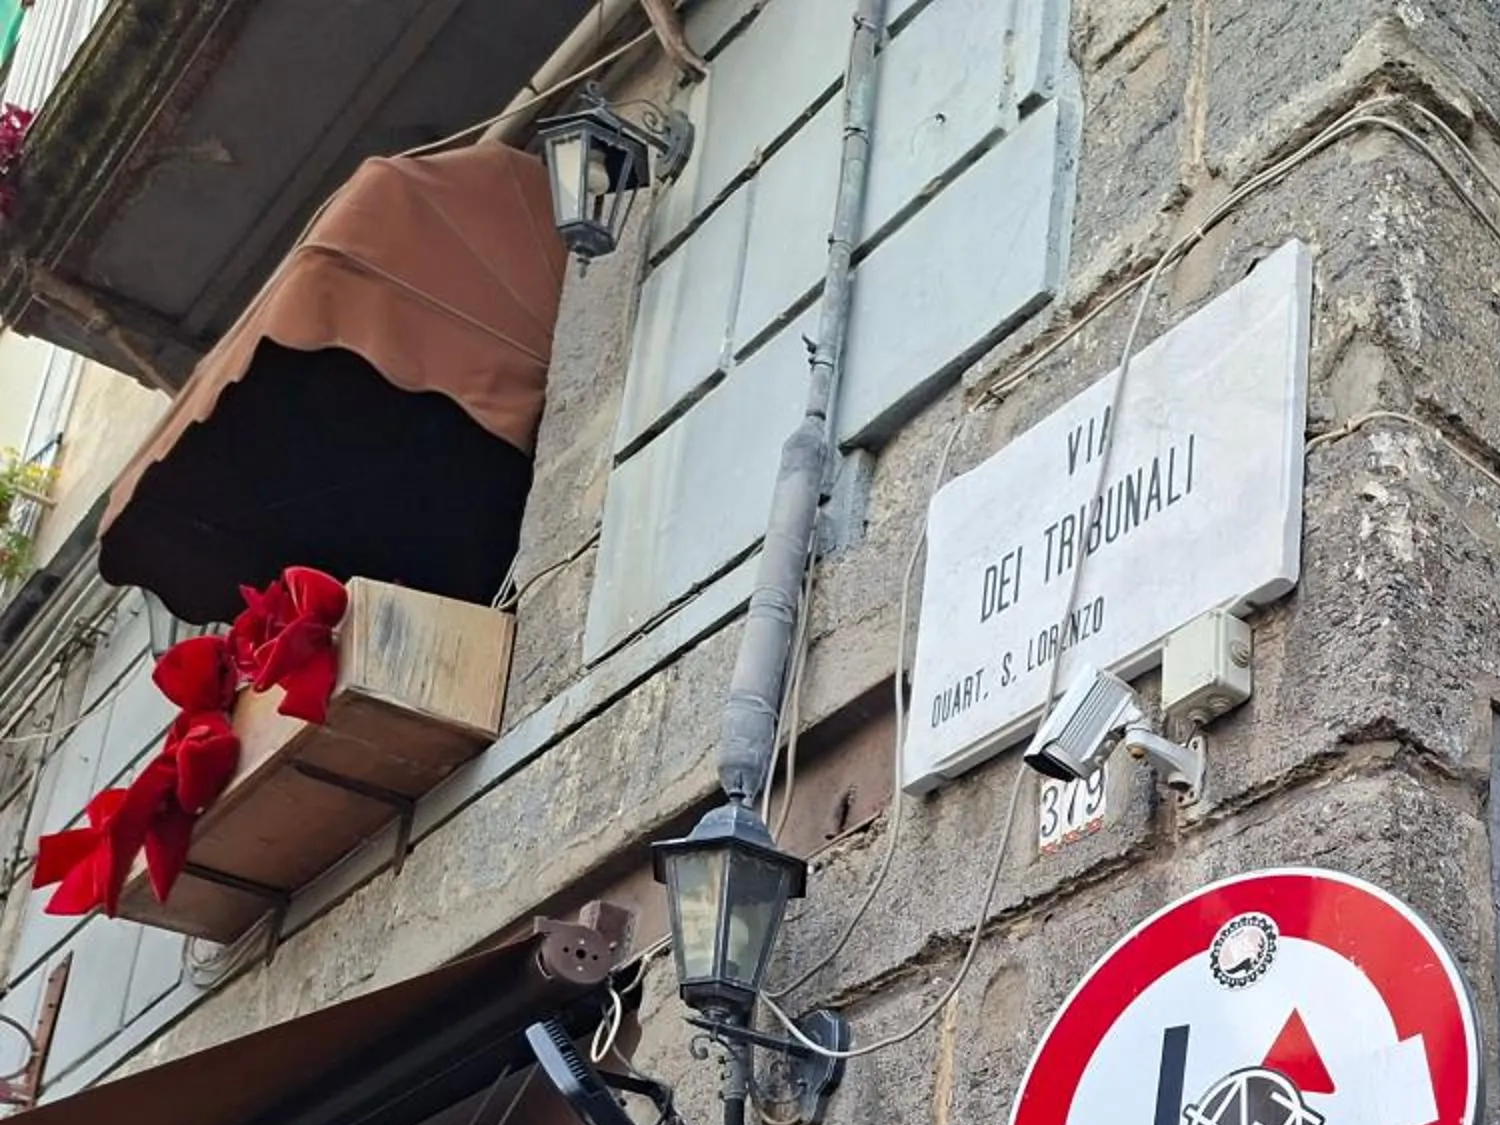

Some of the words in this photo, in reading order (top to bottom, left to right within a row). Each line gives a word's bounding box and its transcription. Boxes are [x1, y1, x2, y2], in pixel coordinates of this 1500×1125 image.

[980, 545, 1024, 624] DEI
[1043, 433, 1195, 585] TRIBUNALI
[1001, 651, 1017, 687] S.
